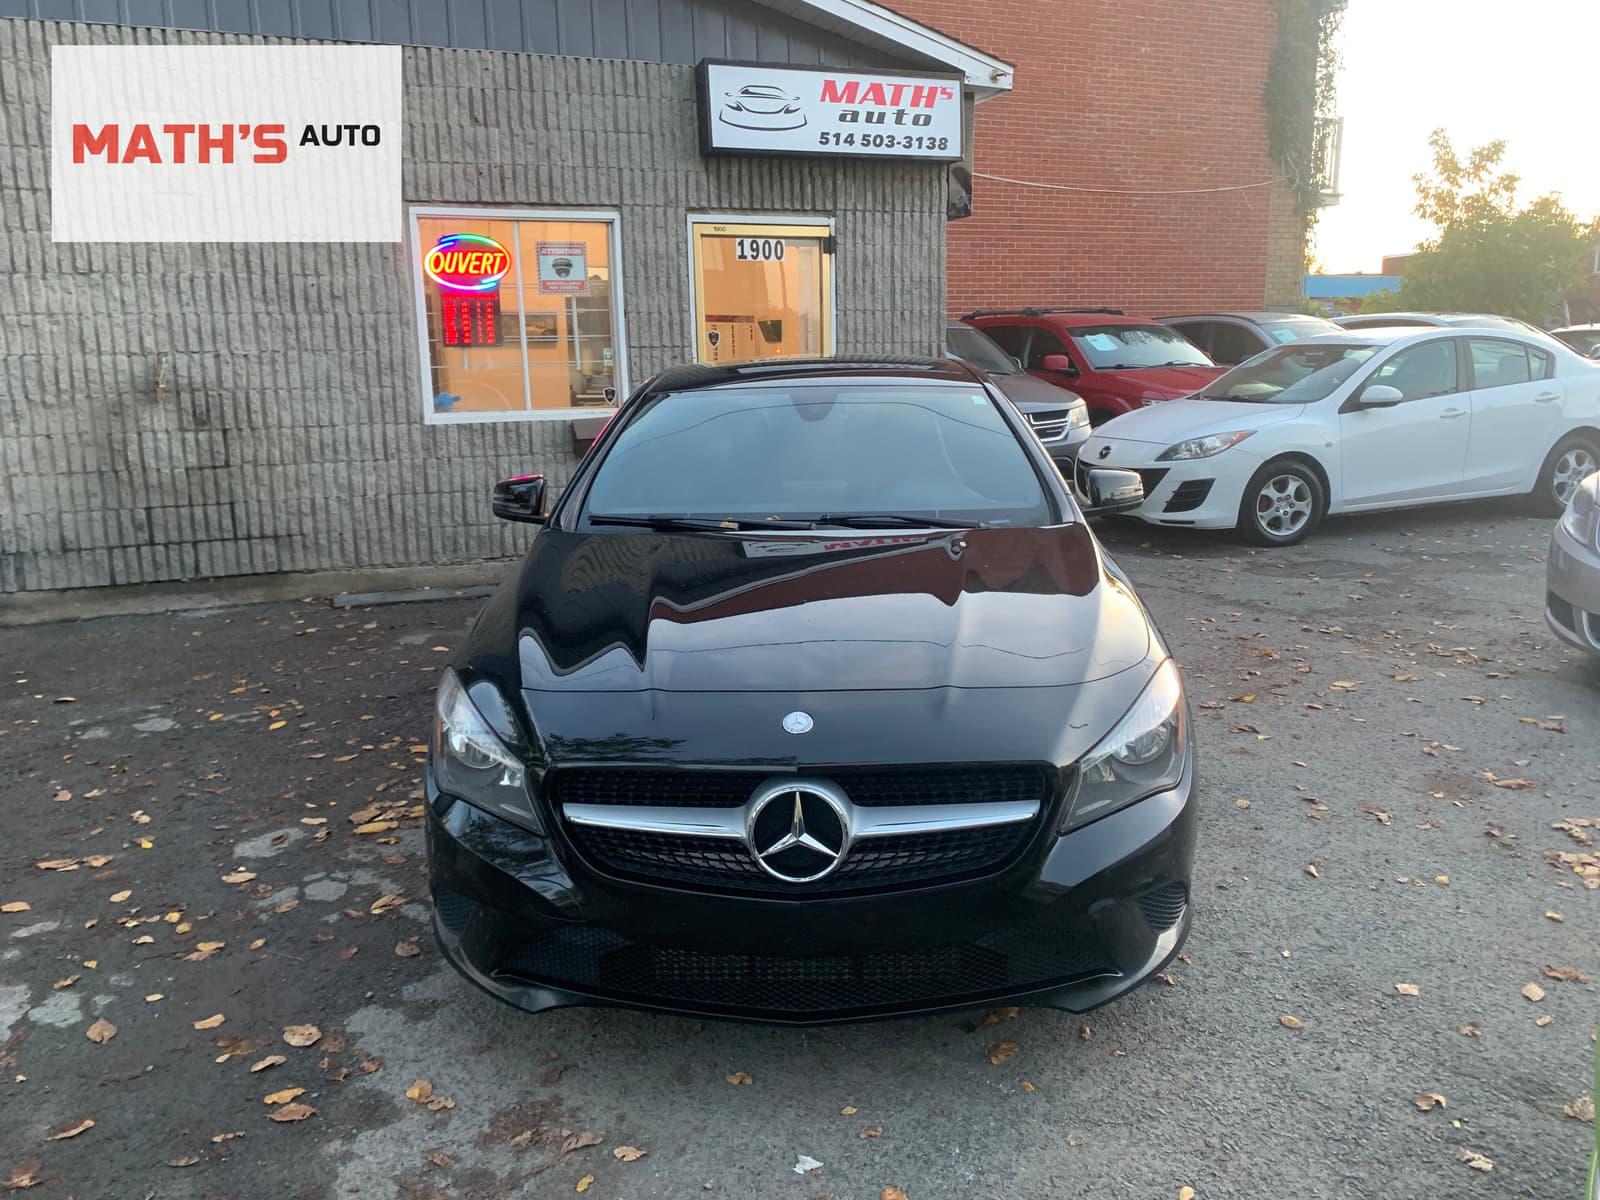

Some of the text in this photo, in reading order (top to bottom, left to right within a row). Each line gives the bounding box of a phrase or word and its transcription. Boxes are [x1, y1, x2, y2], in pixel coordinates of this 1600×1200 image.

[838, 108, 932, 126] auto
[818, 131, 948, 151] 514 503-3138
[737, 239, 784, 260] 1900
[429, 251, 504, 274] OUVERT
